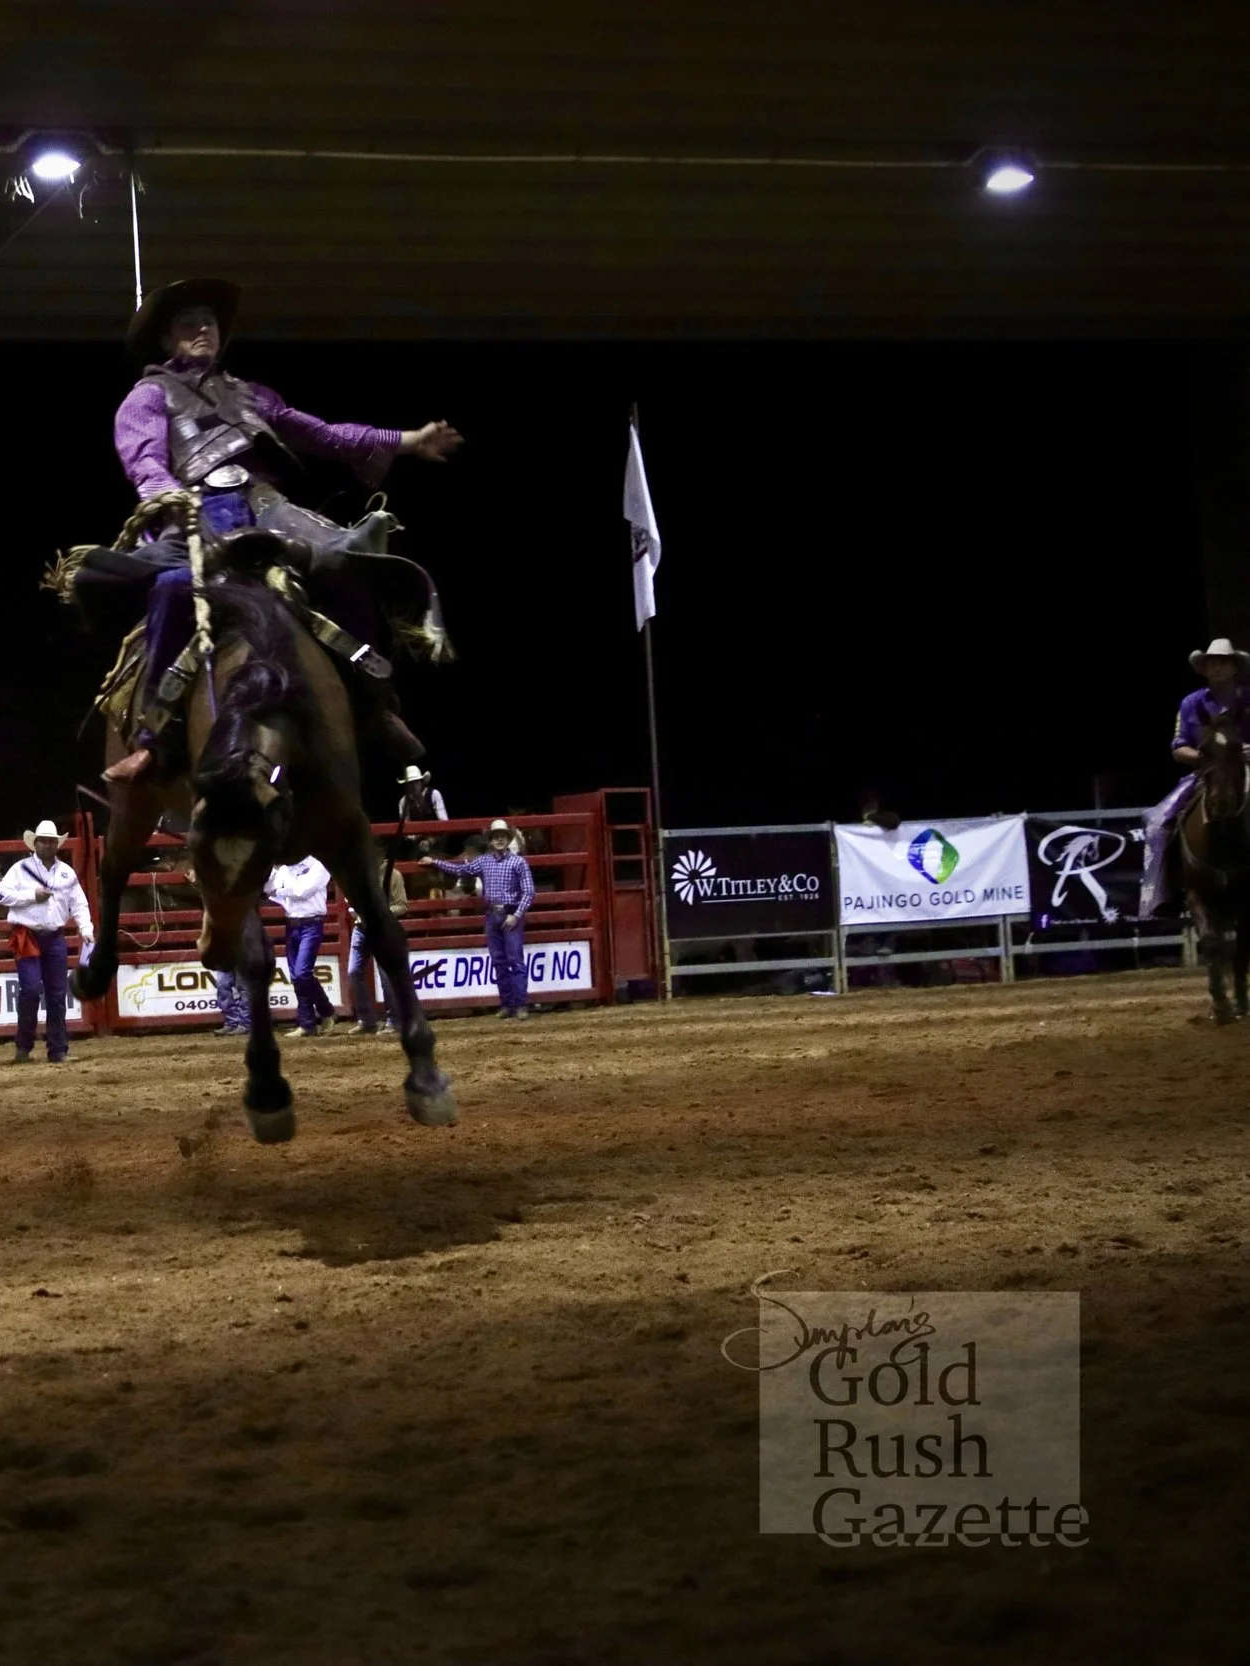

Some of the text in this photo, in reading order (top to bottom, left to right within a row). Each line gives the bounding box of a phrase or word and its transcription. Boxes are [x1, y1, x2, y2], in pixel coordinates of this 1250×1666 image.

[844, 885, 1023, 910] PAJINGO GOLD MINE
[551, 950, 582, 981] NQ
[175, 999, 218, 1011] 0409
